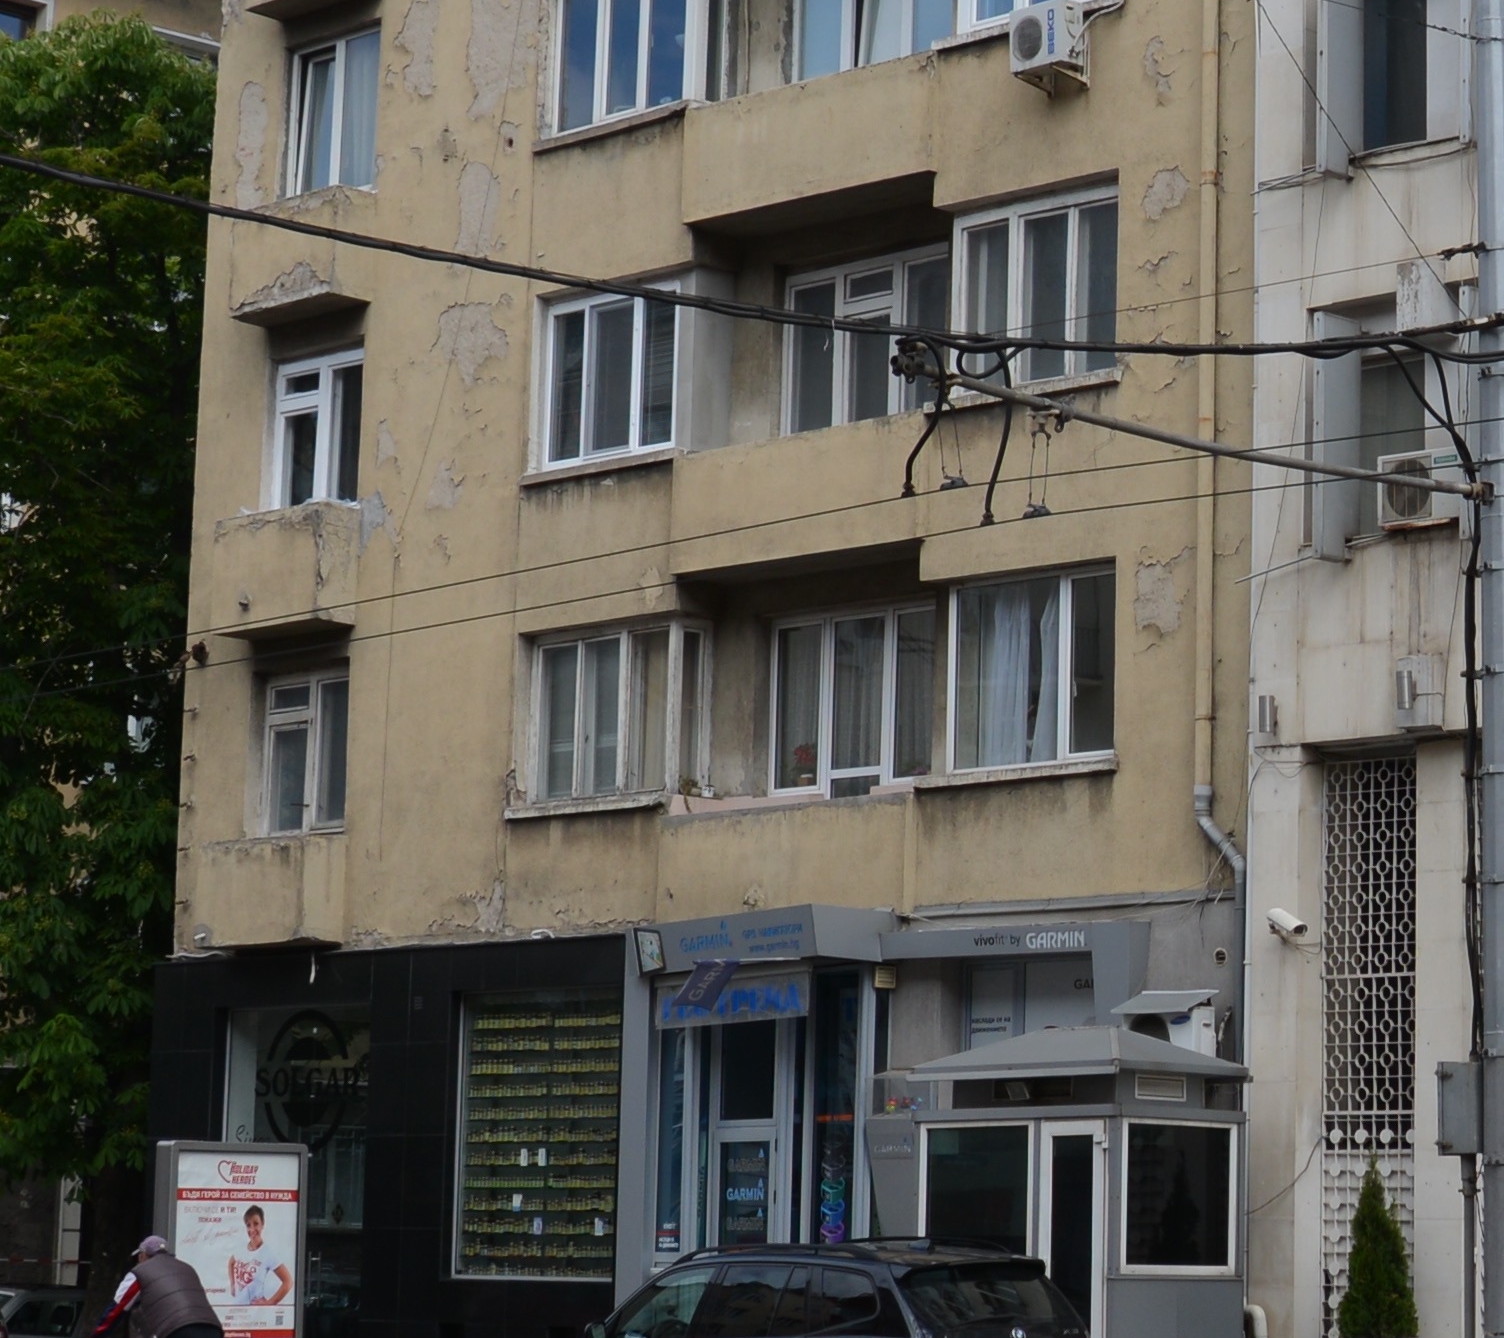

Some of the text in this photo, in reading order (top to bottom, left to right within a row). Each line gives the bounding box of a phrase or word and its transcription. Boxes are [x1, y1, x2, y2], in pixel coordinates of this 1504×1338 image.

[1436, 455, 1456, 464] TOSHIBA
[680, 934, 730, 953] GARMIN
[1010, 934, 1020, 947] by
[1026, 931, 1085, 949] GARMIN
[231, 1162, 258, 1175] HOLIDAY
[232, 1176, 256, 1185] HEROES
[182, 1190, 200, 1199] БЪДИ
[201, 1190, 220, 1198] ГЕРОЙ
[230, 1191, 264, 1199] СЕМЕЙСТВО
[270, 1192, 292, 1200] НУЖДА
[726, 1188, 764, 1200] GARMIN
